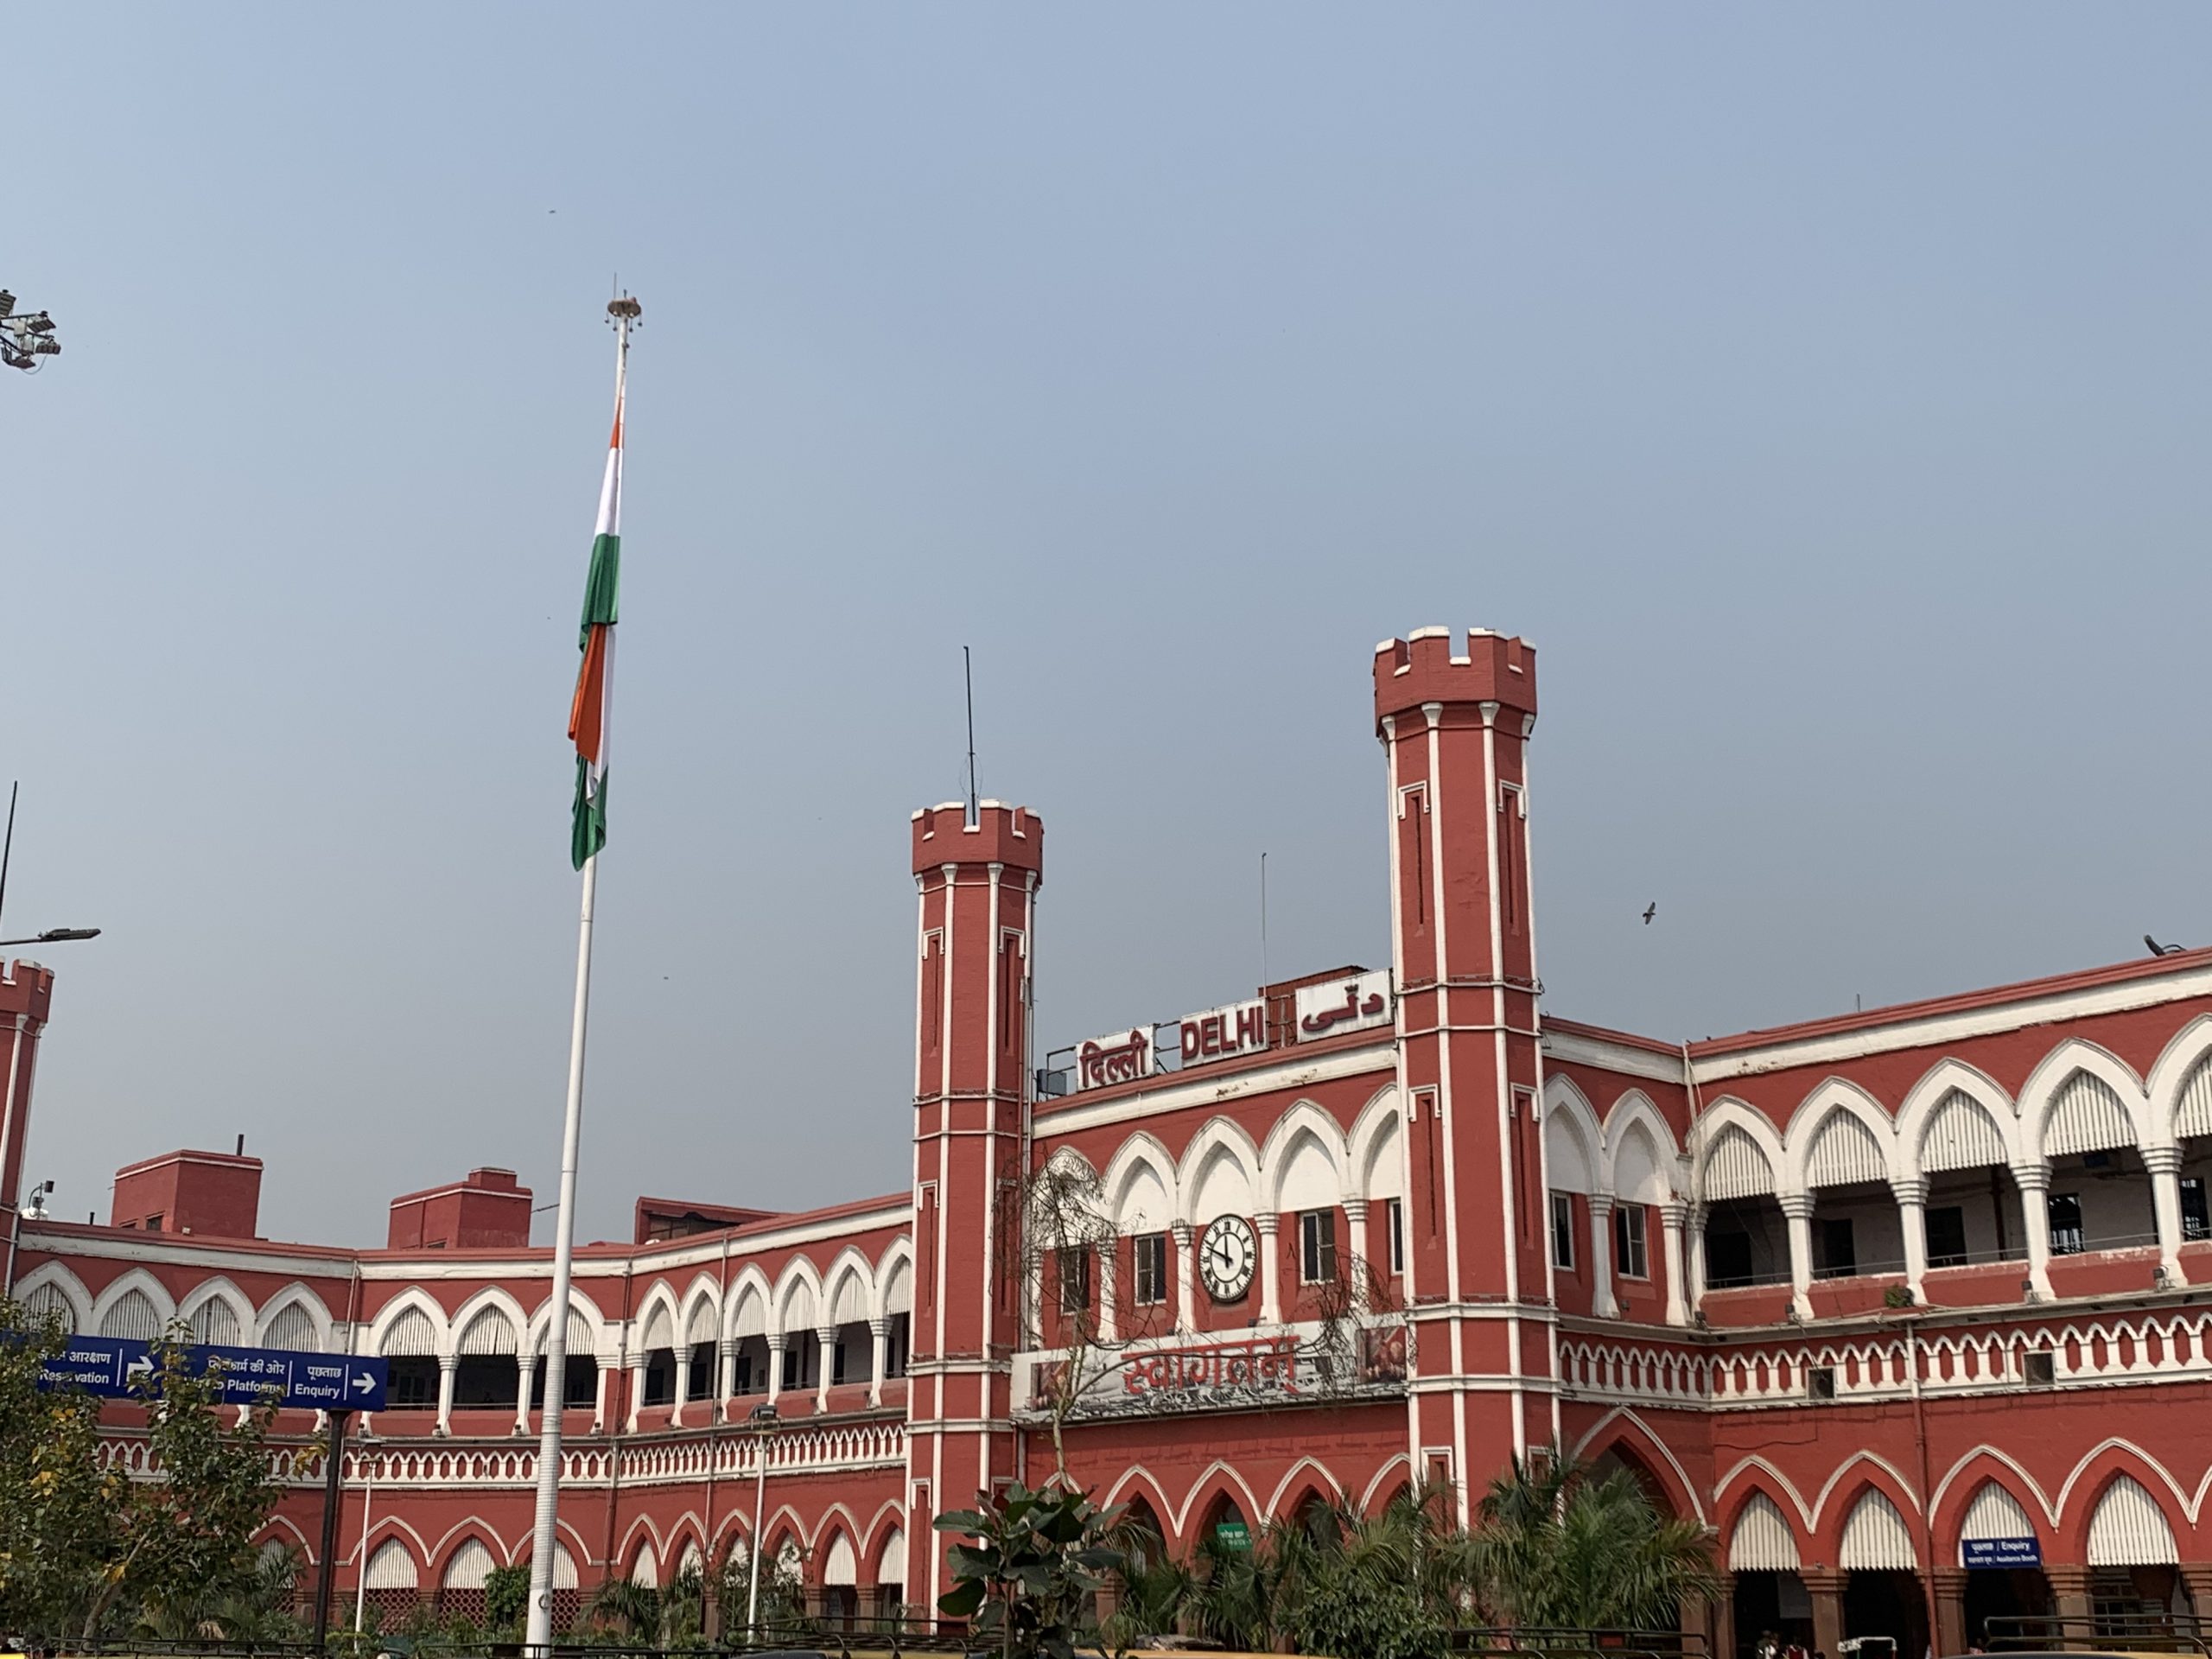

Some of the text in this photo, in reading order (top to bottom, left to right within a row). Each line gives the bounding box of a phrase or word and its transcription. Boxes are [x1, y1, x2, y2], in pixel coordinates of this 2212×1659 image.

[1181, 1006, 1264, 1059] DELHI
[1079, 1031, 1148, 1088] दिल्ली
[69, 1351, 111, 1363] आरक्षण
[250, 1359, 264, 1373] की
[266, 1360, 286, 1375] ओर
[308, 1366, 342, 1381] पूछताछ
[1121, 1336, 1300, 1395] स्वागतम्
[40, 1369, 110, 1384] Resvation
[295, 1383, 340, 1399] Enquiry
